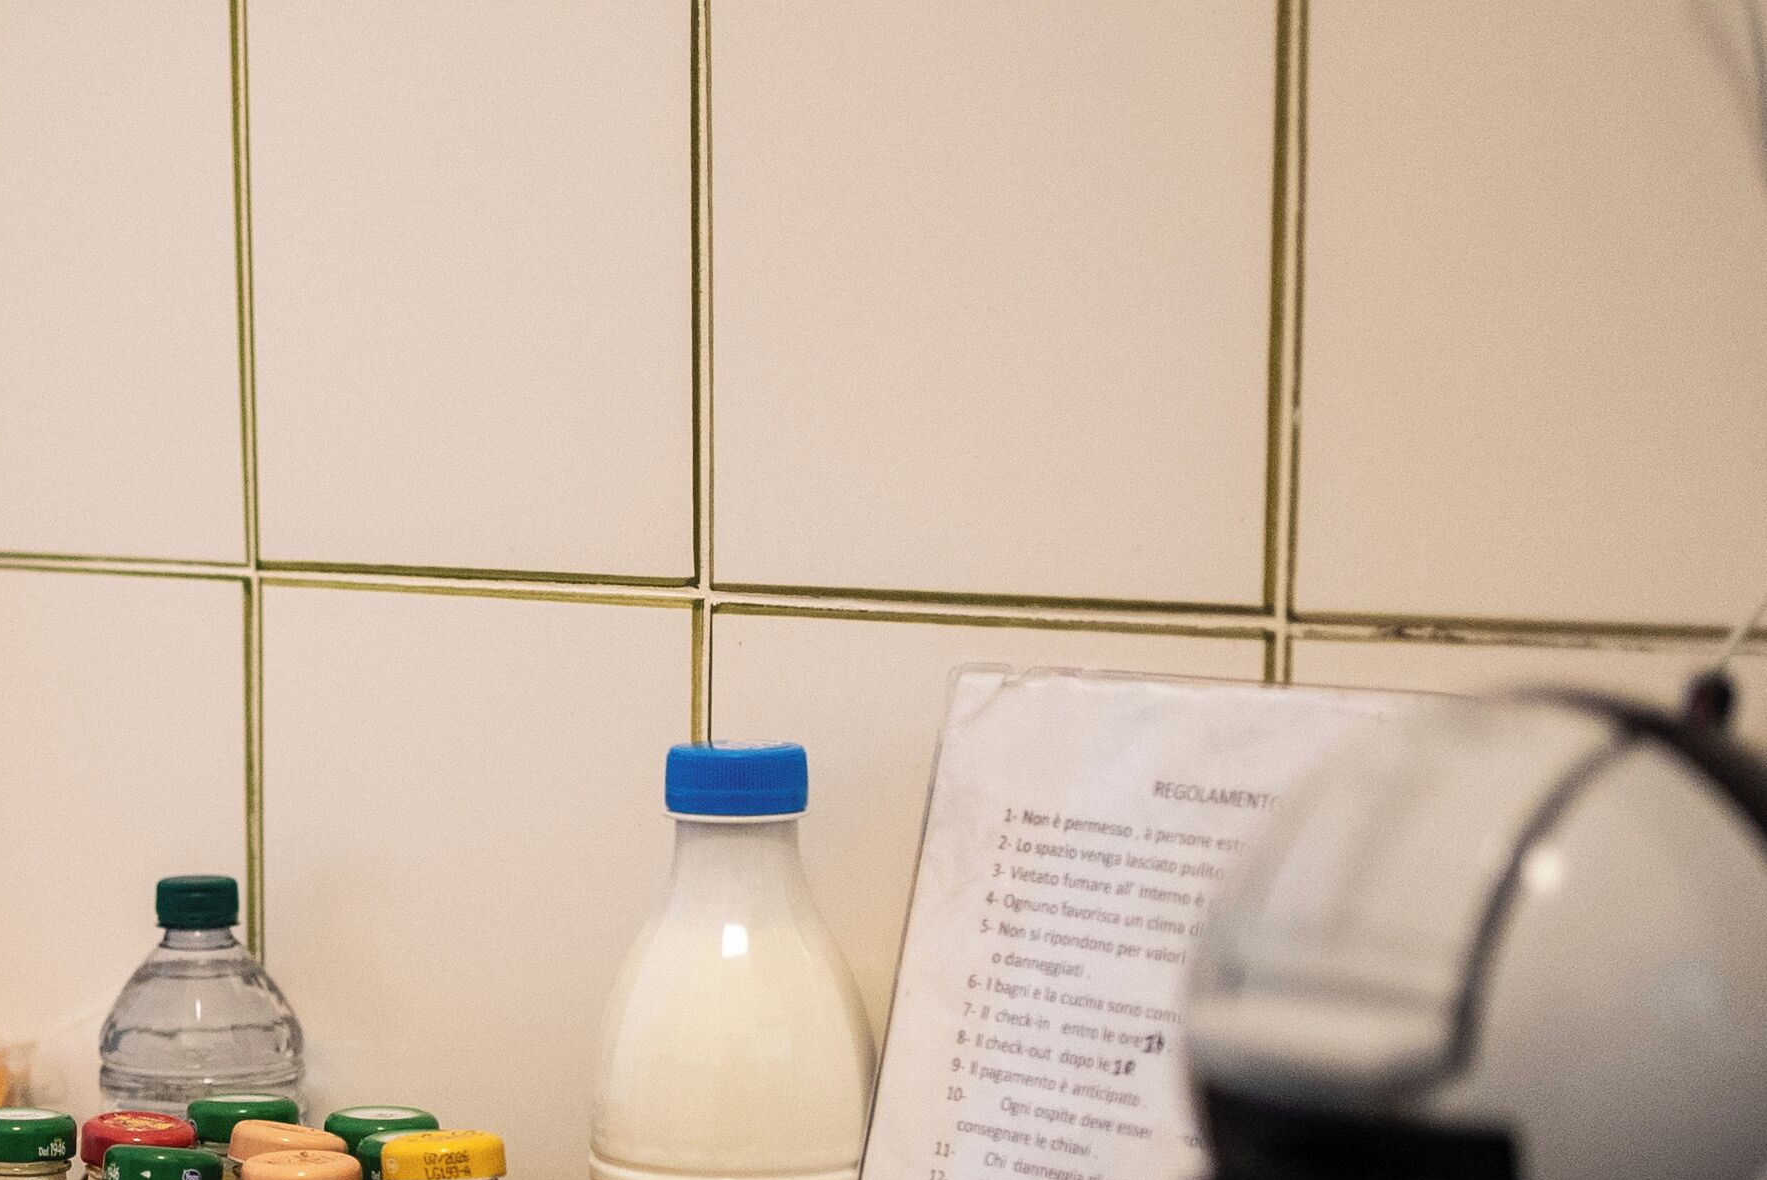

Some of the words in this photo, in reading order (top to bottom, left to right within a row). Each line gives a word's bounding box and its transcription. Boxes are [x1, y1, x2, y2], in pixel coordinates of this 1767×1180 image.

[1021, 809, 1050, 826] Non
[1053, 813, 1062, 829] è
[1063, 818, 1133, 838] permesso
[1155, 830, 1212, 849] persone
[1016, 838, 1032, 853] Lo
[1035, 843, 1077, 860] spazio
[1080, 849, 1122, 868] venga
[1126, 853, 1177, 873] lasciato
[1011, 866, 1059, 885] Vietato
[1062, 872, 1112, 894] fumare
[1139, 886, 1191, 906] interno
[1003, 893, 1058, 914] Ognuno
[1061, 901, 1122, 924] favorisca
[1124, 915, 1143, 929] un
[1146, 917, 1186, 935] clima
[998, 921, 1026, 938] Non
[1030, 927, 1040, 941] si
[1115, 943, 1140, 960] per
[994, 978, 1030, 999] bagni
[1032, 986, 1041, 1000] e
[1045, 987, 1057, 1002] la
[1060, 993, 1105, 1011] cucina
[1108, 1000, 1142, 1018] sono
[995, 1009, 1050, 1030] check-in
[1061, 1021, 1100, 1041] entro
[1102, 1026, 1115, 1043] le
[985, 1036, 1052, 1060] check-out
[1059, 1048, 1094, 1069] dopo
[979, 1065, 1057, 1090] pagamento
[947, 1086, 966, 1101] 10-
[1000, 1097, 1031, 1117] Ogni
[1033, 1103, 1077, 1125] ospite
[1080, 1114, 1114, 1132] deve
[956, 1120, 1032, 1144] consegnare
[1035, 1133, 1047, 1149] le
[935, 1141, 954, 1157] 11-
[984, 1151, 1007, 1169] Chi
